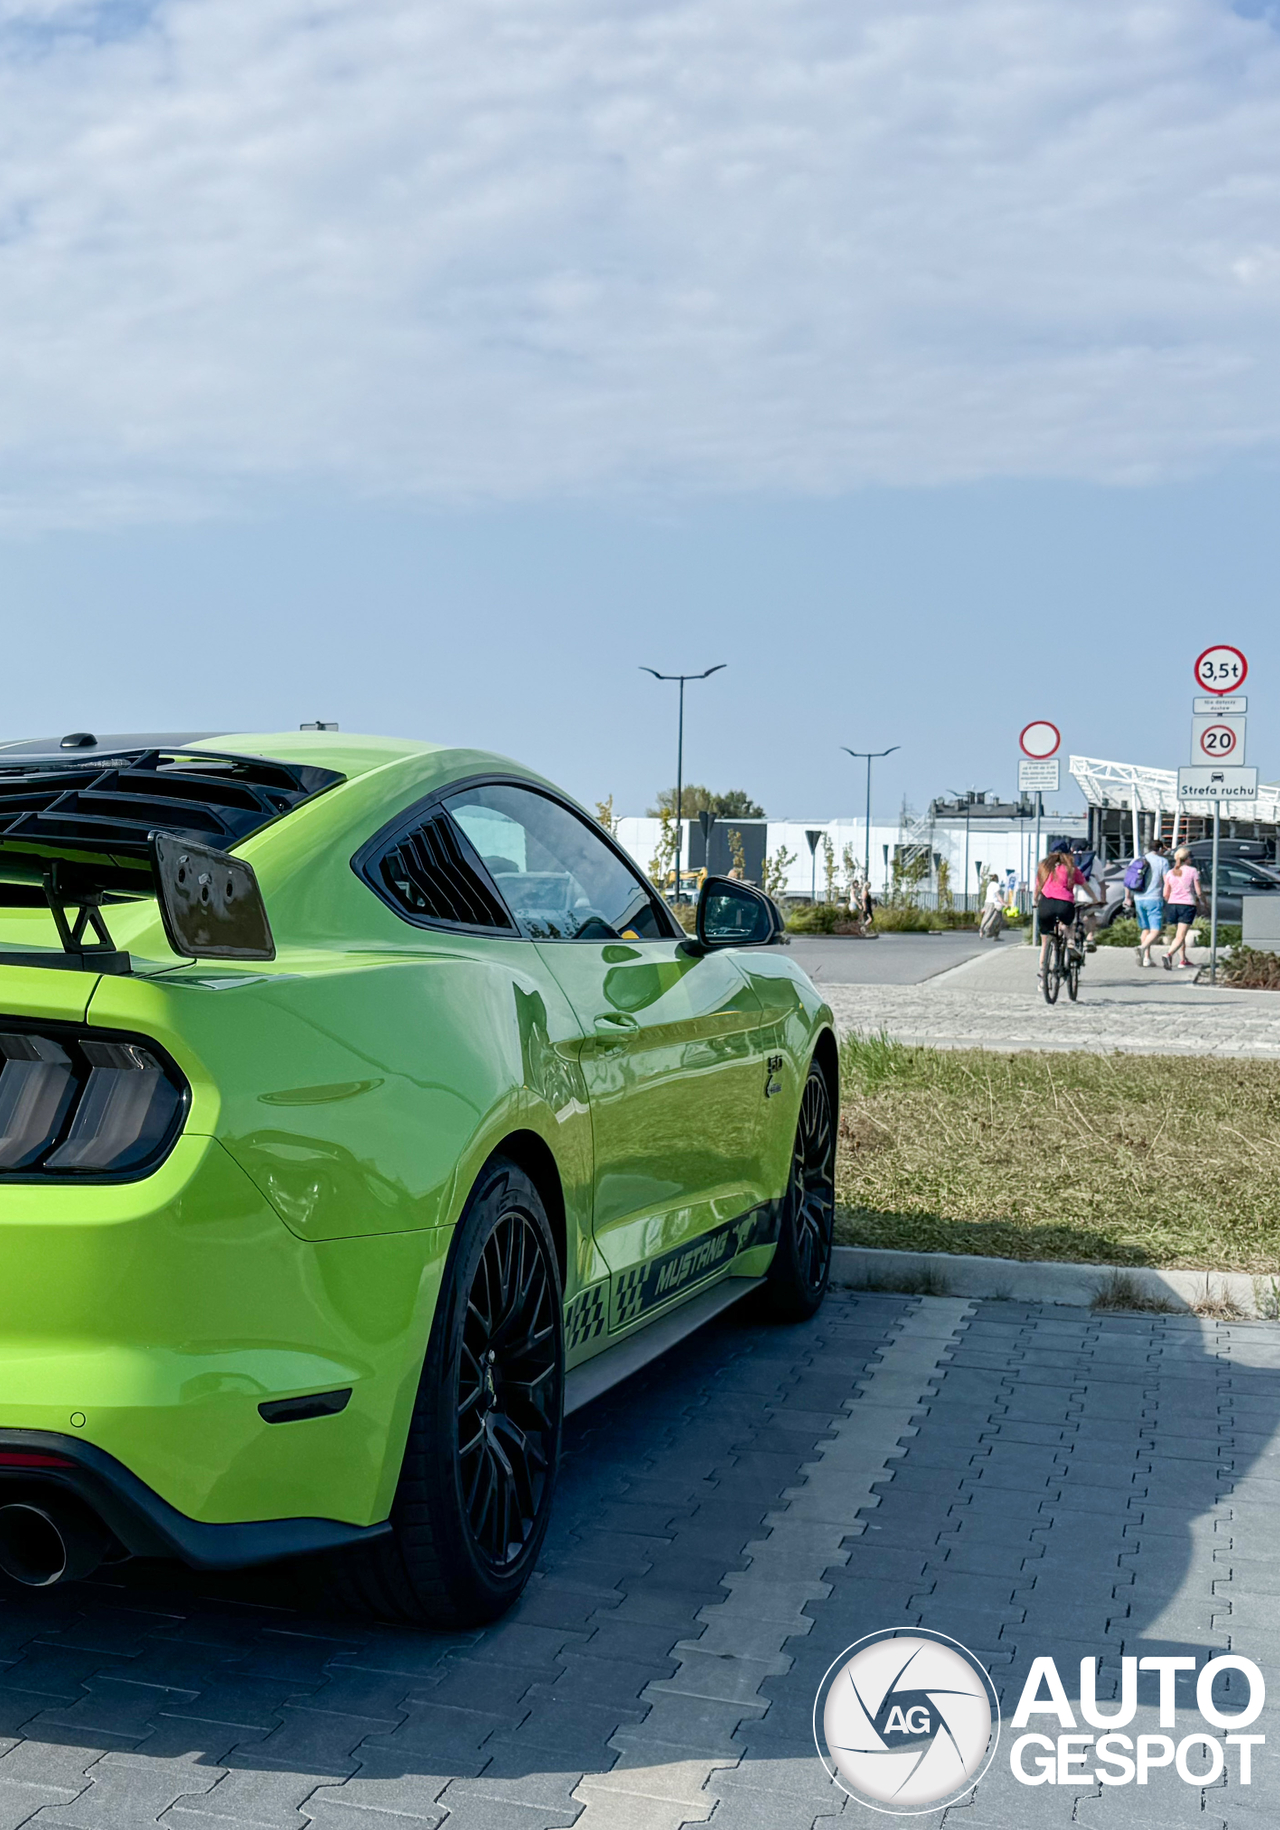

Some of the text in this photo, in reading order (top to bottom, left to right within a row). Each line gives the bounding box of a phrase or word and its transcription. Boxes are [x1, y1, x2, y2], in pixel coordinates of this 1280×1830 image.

[1205, 733, 1232, 749] 20
[1181, 785, 1254, 796] Strefa ruchu
[654, 1230, 730, 1296] MUSTANG
